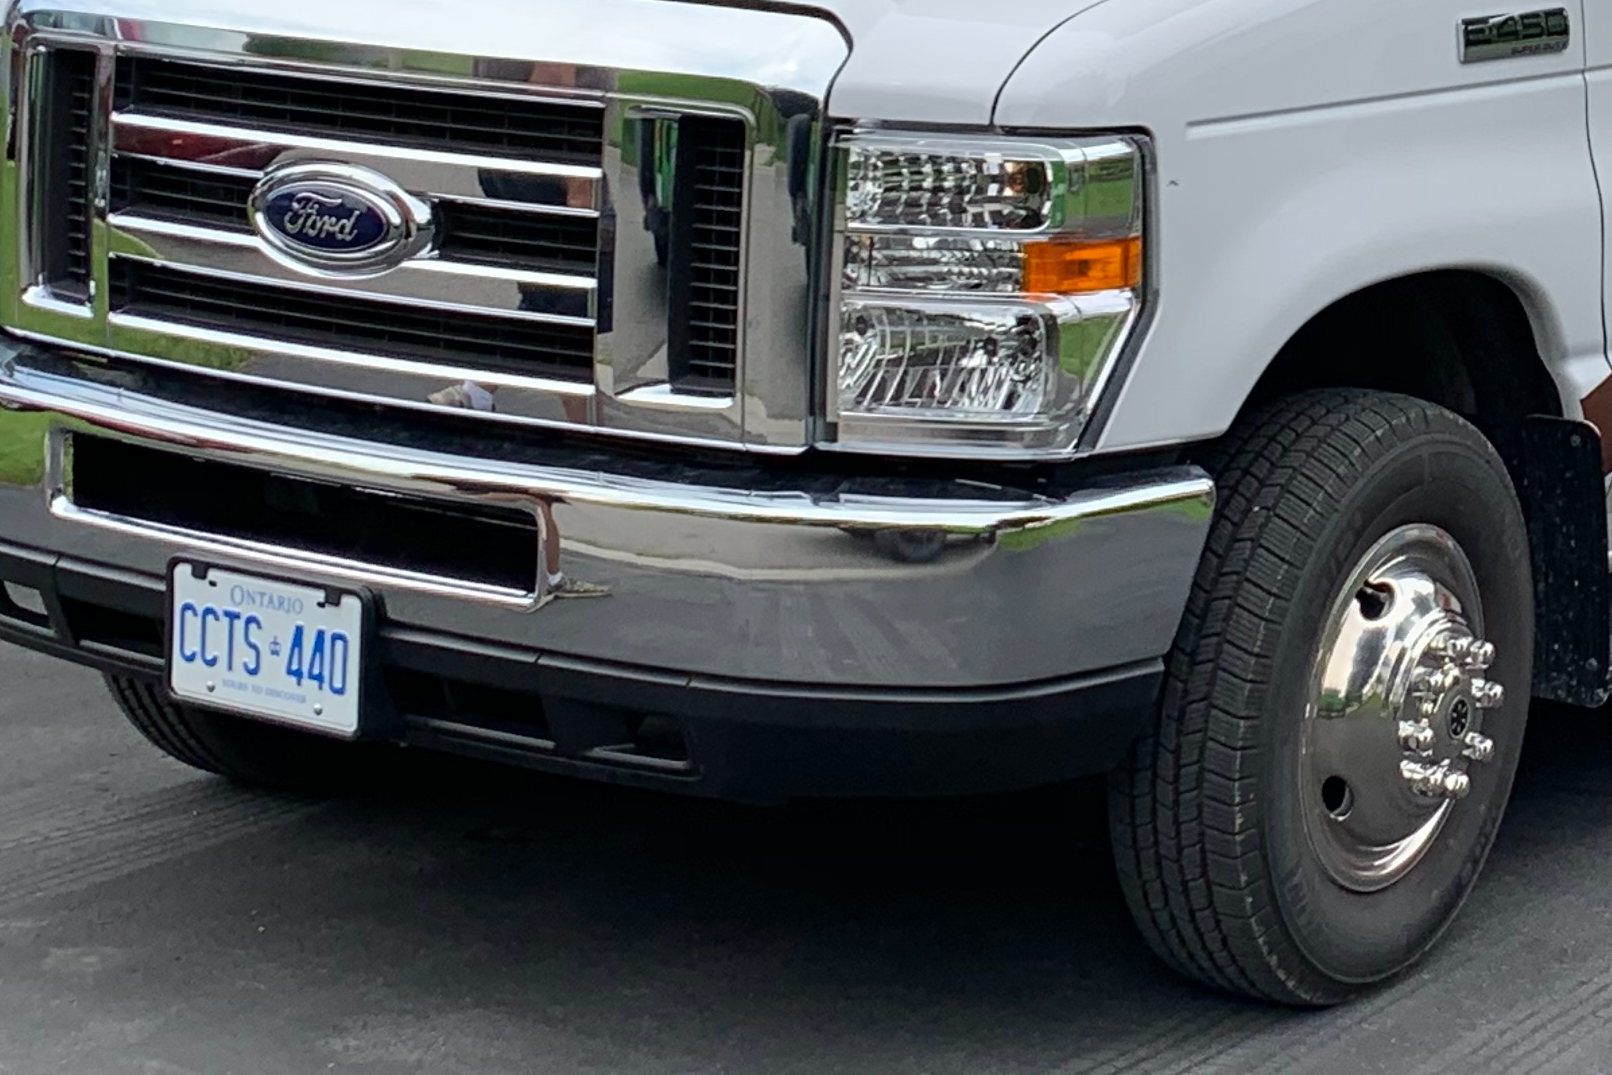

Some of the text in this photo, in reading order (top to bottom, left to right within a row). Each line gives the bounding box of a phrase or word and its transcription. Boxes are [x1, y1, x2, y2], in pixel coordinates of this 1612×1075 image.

[284, 191, 361, 242] Ford
[179, 601, 349, 696] CCTS 440
